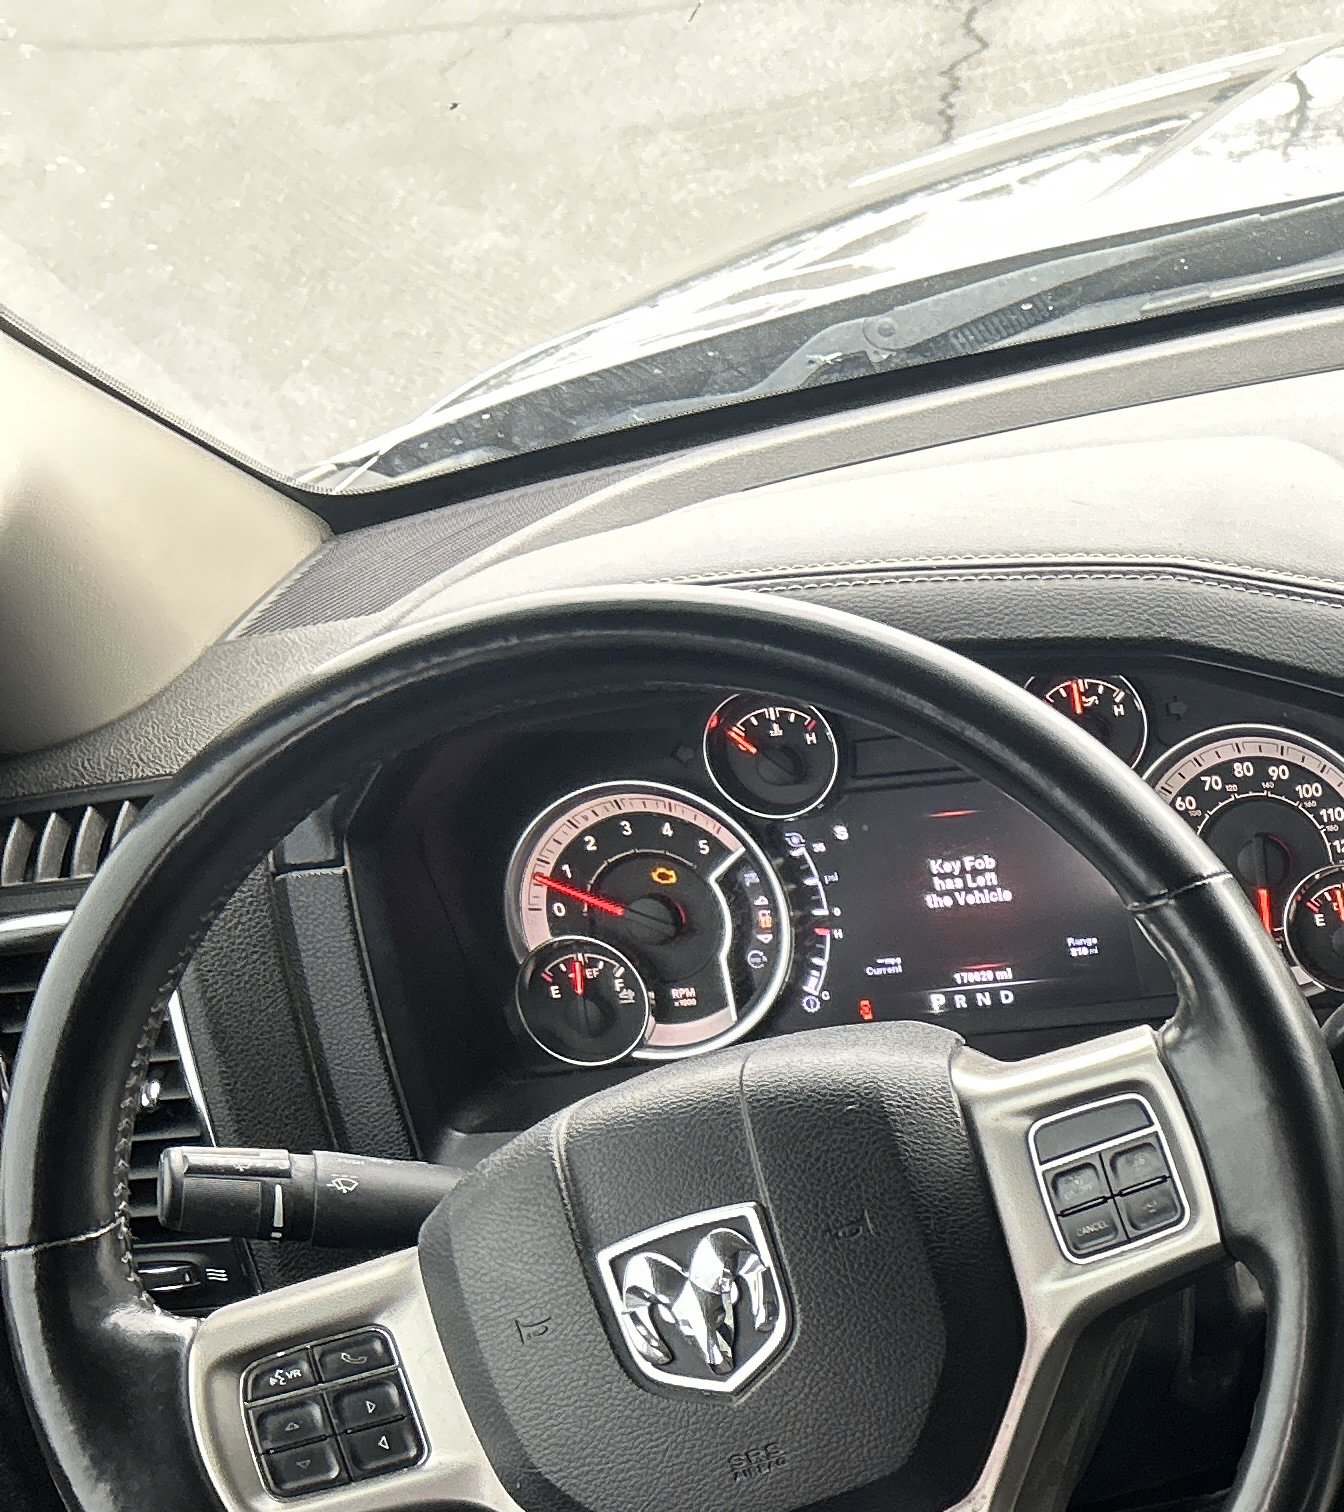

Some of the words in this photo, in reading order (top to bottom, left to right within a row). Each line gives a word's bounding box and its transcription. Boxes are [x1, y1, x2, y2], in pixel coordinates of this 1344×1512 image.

[1113, 704, 1125, 717] H
[805, 732, 817, 745] H
[1233, 762, 1254, 778] 80
[1268, 765, 1290, 780] 90
[1201, 776, 1223, 791] 70
[1295, 782, 1323, 799] 100
[1175, 795, 1197, 811] 60
[1319, 806, 1344, 822] 110
[620, 821, 633, 836] 3
[661, 821, 674, 837] 4
[584, 835, 598, 851] 2
[697, 839, 710, 855] 5
[561, 863, 572, 879] 1
[930, 858, 961, 876] Key
[962, 855, 996, 871] Fob
[932, 876, 964, 891] has
[965, 871, 998, 888] Left
[925, 893, 953, 909] the
[953, 888, 1013, 906] Vehicle
[552, 902, 566, 917] 0
[1314, 913, 1326, 927] E
[865, 964, 902, 976] Current
[550, 985, 562, 999] E
[614, 979, 625, 992] F
[671, 987, 697, 999] RPM
[929, 993, 946, 1011] P
[954, 994, 968, 1009] R
[975, 992, 992, 1007] N
[1000, 990, 1014, 1004] D
[1076, 1220, 1110, 1237] CANCEL
[285, 1369, 302, 1380] VR
